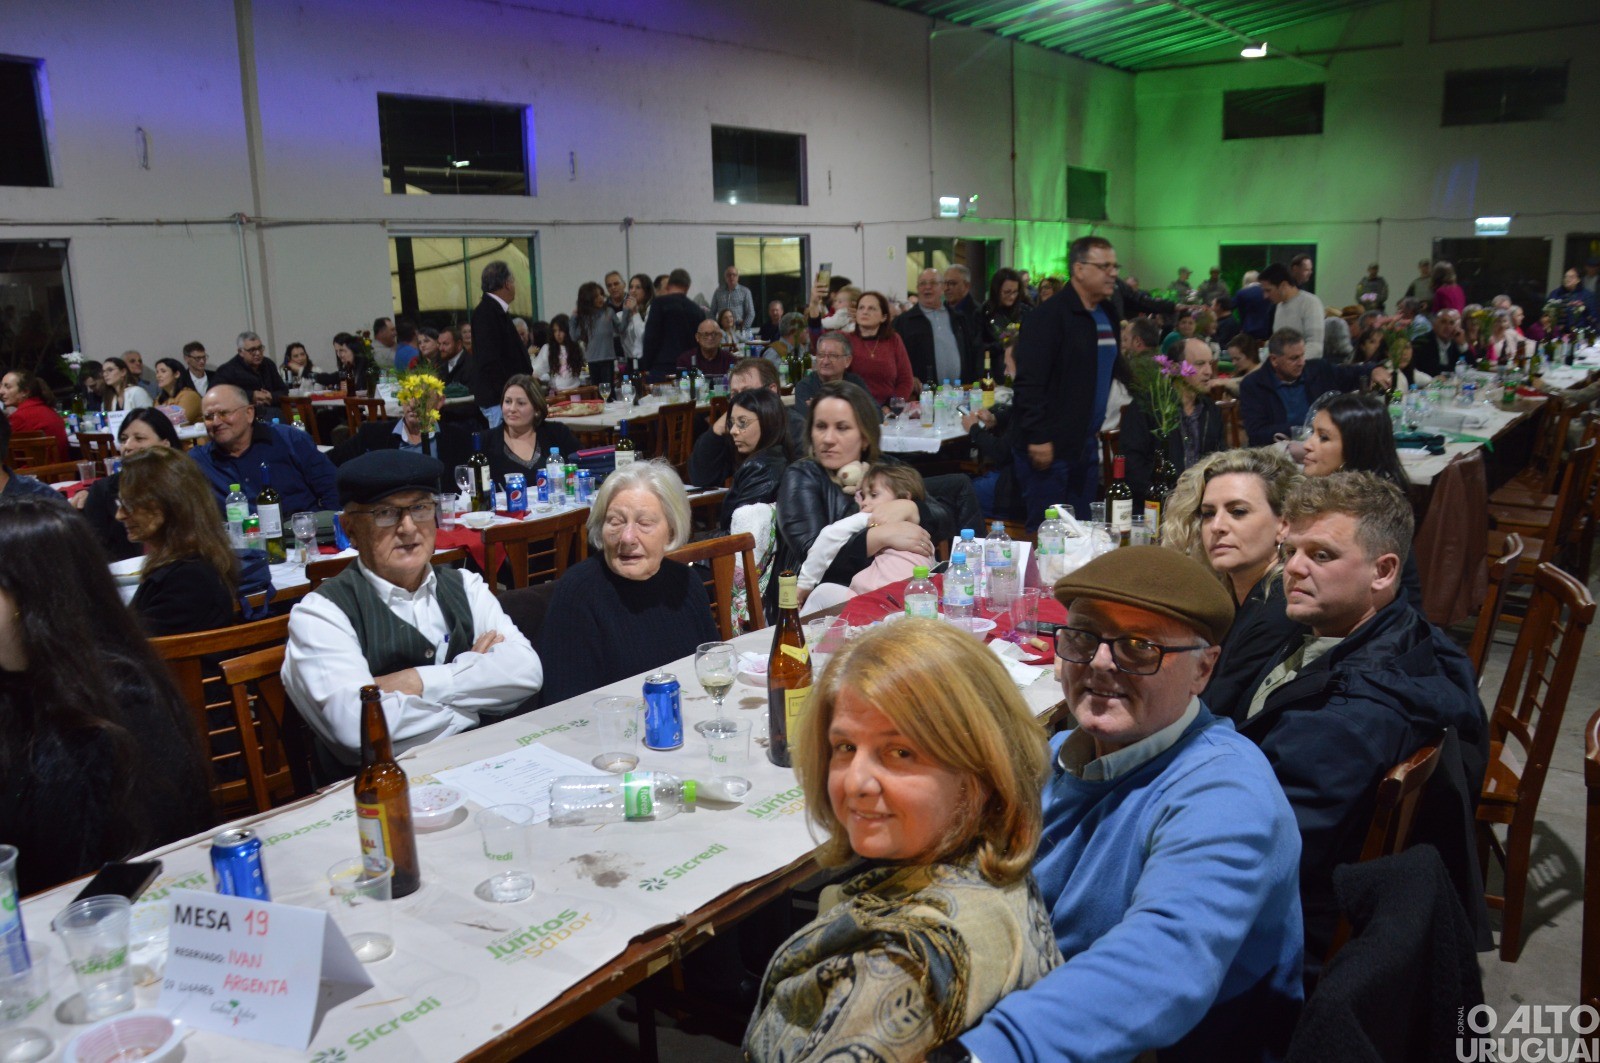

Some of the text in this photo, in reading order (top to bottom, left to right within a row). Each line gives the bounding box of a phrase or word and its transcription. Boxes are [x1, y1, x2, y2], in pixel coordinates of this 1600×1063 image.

[515, 724, 571, 746] Sicredi
[663, 843, 728, 880] Sicredi
[174, 904, 269, 936] MESA 19
[486, 908, 578, 959] Juntos
[523, 912, 592, 958] sabor
[227, 948, 263, 968] IVAN
[223, 973, 288, 996] ARGENTA
[346, 996, 442, 1051] Sicredi
